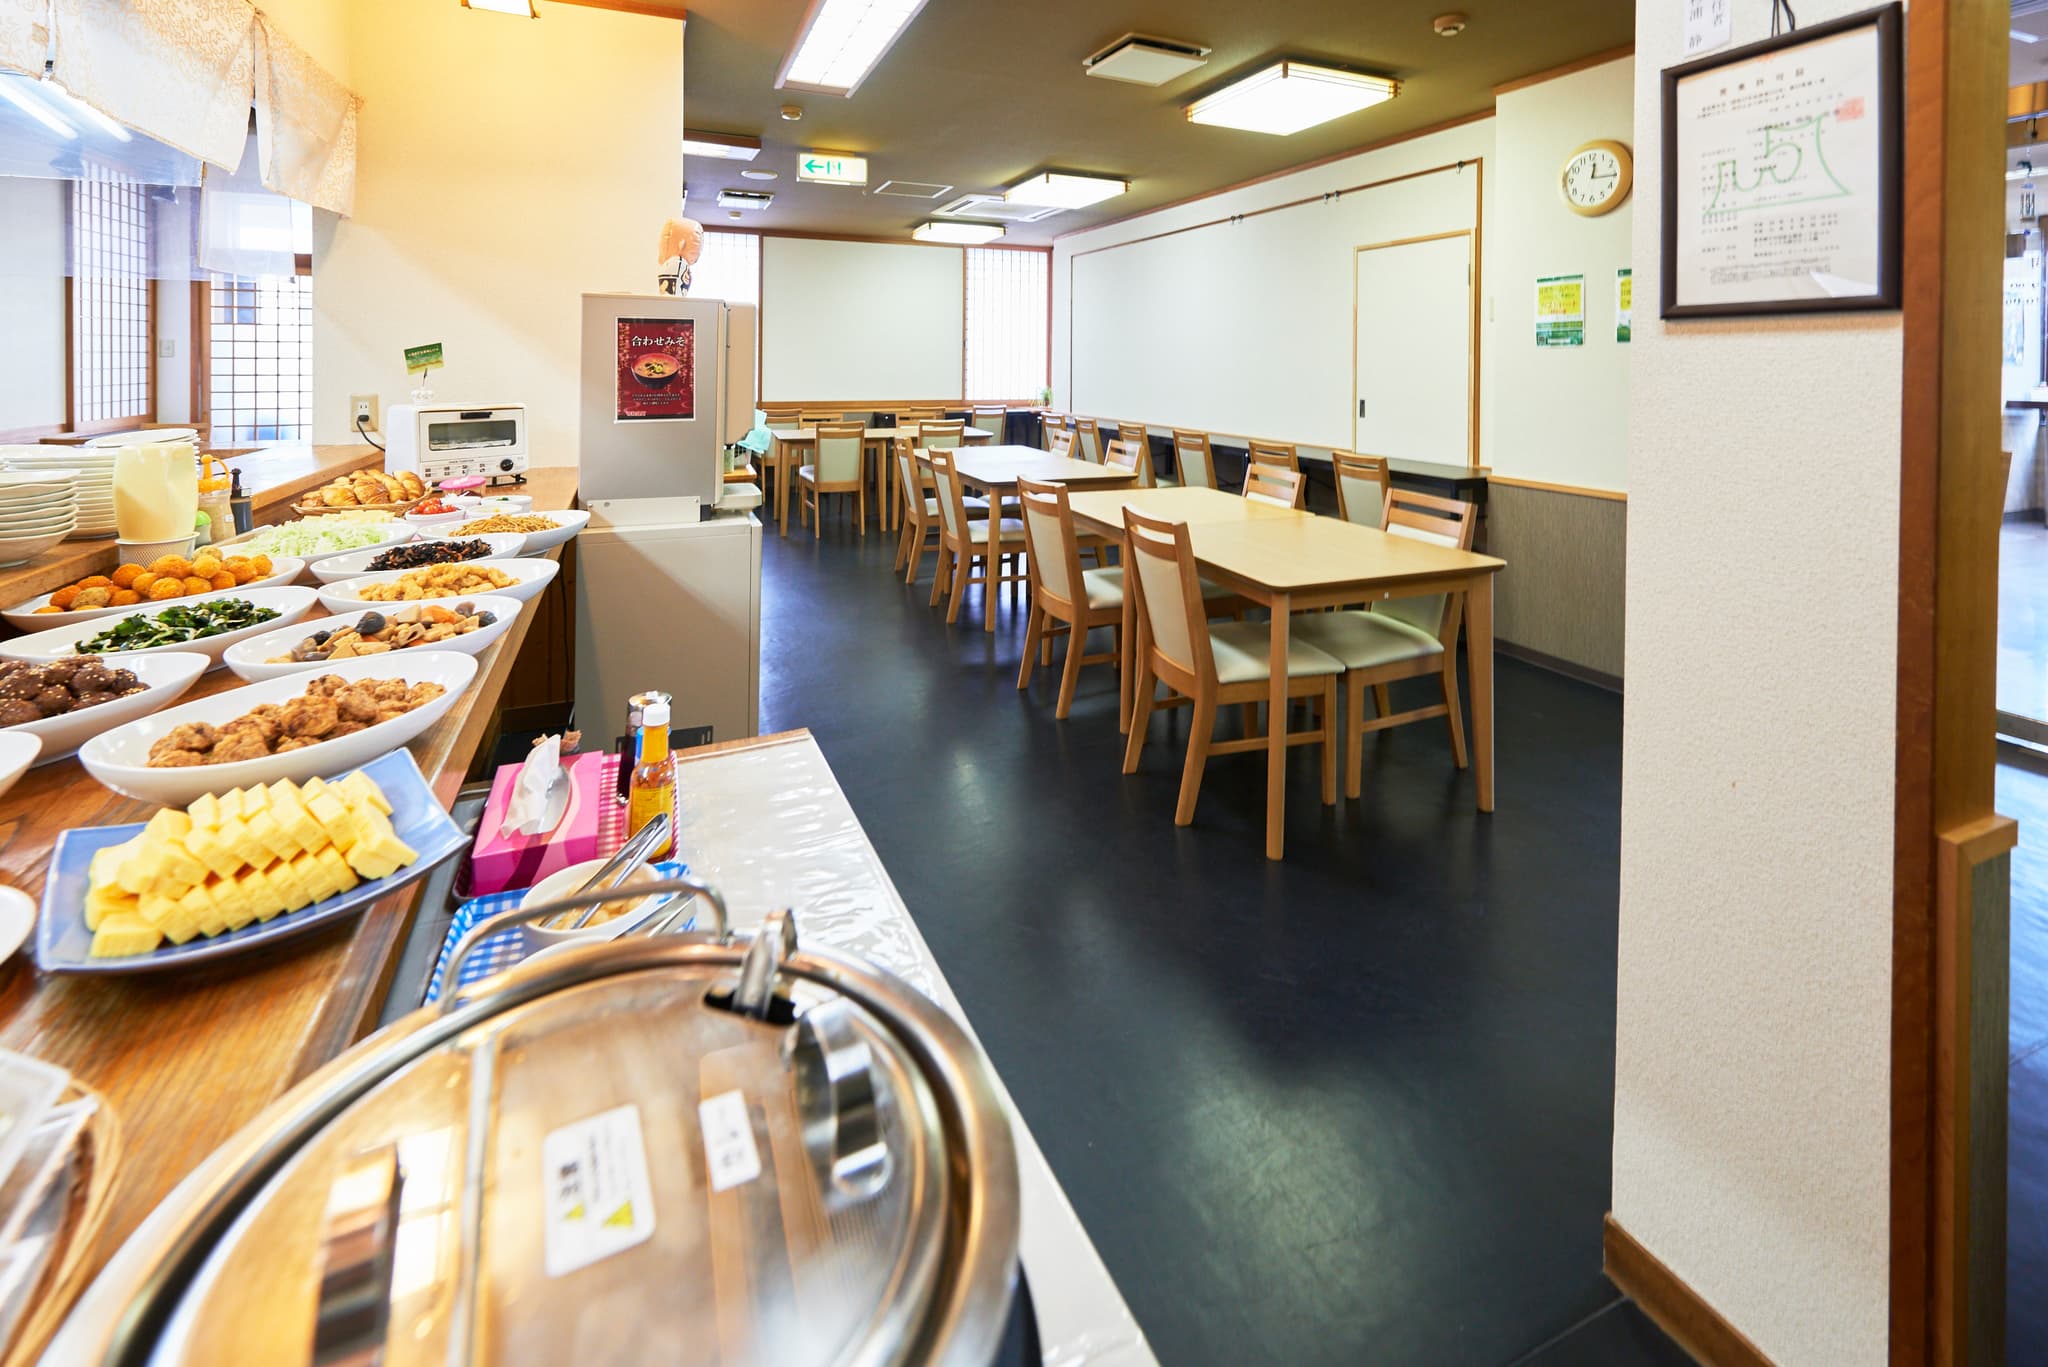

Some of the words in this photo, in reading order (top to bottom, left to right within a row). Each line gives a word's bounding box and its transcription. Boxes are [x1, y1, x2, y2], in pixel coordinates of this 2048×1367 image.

[1580, 157, 1587, 166] 11
[1588, 152, 1597, 162] 12
[1608, 159, 1614, 168] 2
[1571, 166, 1581, 176] 10
[1568, 177, 1575, 187] 9
[1607, 181, 1614, 192] 4
[1571, 187, 1578, 197] 8
[1589, 195, 1596, 203] 6
[631, 335, 685, 347] 合わせみそ
